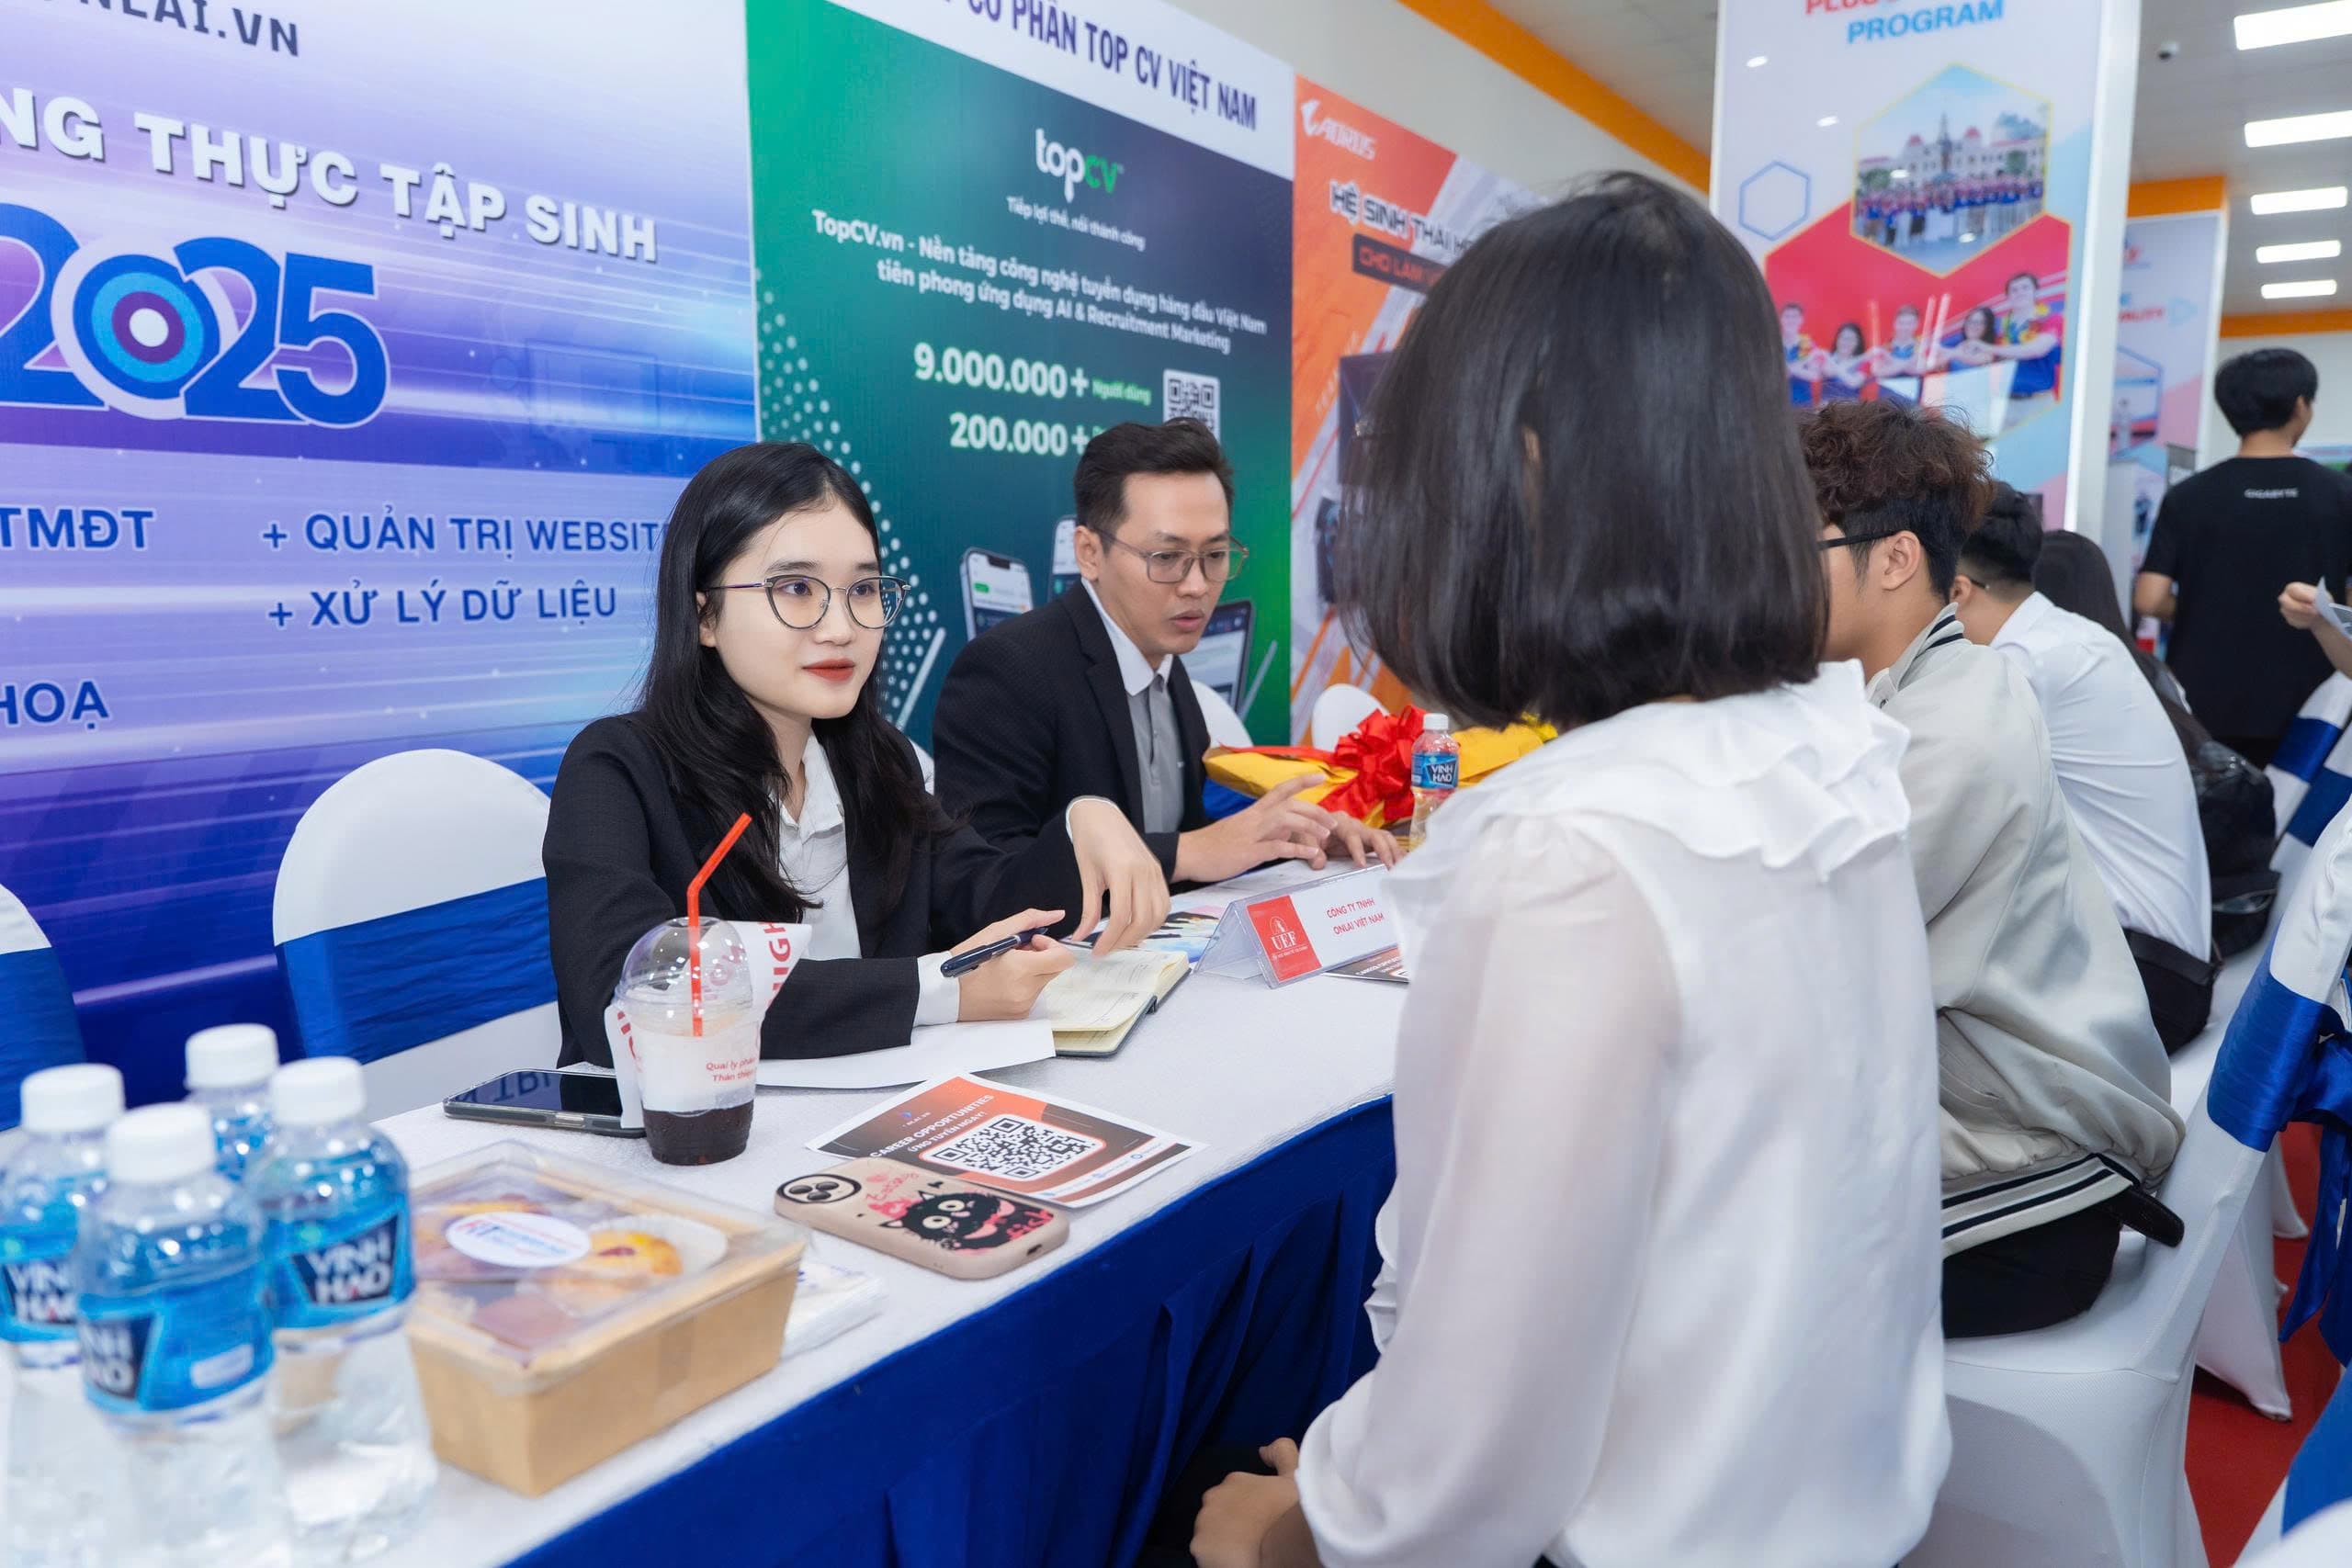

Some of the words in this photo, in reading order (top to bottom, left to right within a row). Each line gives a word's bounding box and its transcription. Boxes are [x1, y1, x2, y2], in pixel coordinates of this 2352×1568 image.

[79, 0, 299, 56] LAI.VN
[1847, 0, 2004, 44] PROGRAM
[1085, 22, 1128, 73] TOP
[1135, 46, 1161, 89] CV
[1169, 60, 1211, 113] VIỆT
[1217, 82, 1257, 130] NAM
[134, 111, 359, 209] THỰC
[380, 163, 507, 238] TẬP
[526, 196, 660, 265] SINH
[1363, 196, 1408, 238] SINH
[812, 209, 904, 253] TopCV.vn
[919, 234, 956, 265] Nền
[1041, 268, 1080, 297] nghệ
[1240, 315, 1268, 335] Nam
[0, 201, 390, 429] 2025
[876, 258, 915, 286] tiên
[919, 269, 975, 304] phong
[978, 279, 1011, 310] ứng
[1013, 288, 1053, 319] dụng
[1056, 298, 1073, 319] AI
[1074, 302, 1086, 321] &
[1087, 304, 1170, 339] Recruitment
[1170, 323, 1231, 355] Marketing
[0, 507, 154, 548] TMĐT
[262, 525, 288, 550] +
[305, 503, 436, 553] QUẢN
[449, 517, 514, 561] TRỊ
[268, 603, 293, 628] +
[311, 580, 379, 626] XỬ
[397, 580, 446, 625] LÝ
[461, 580, 522, 621] DỮ
[537, 579, 616, 626] LIỆU
[1327, 905, 1347, 919] CÔNG
[1347, 903, 1356, 912] TY
[1357, 897, 1375, 910] TNHH
[1271, 931, 1296, 950] UEF
[869, 1136, 914, 1158] CAREER
[914, 1094, 995, 1138] OPPORTUNITIES
